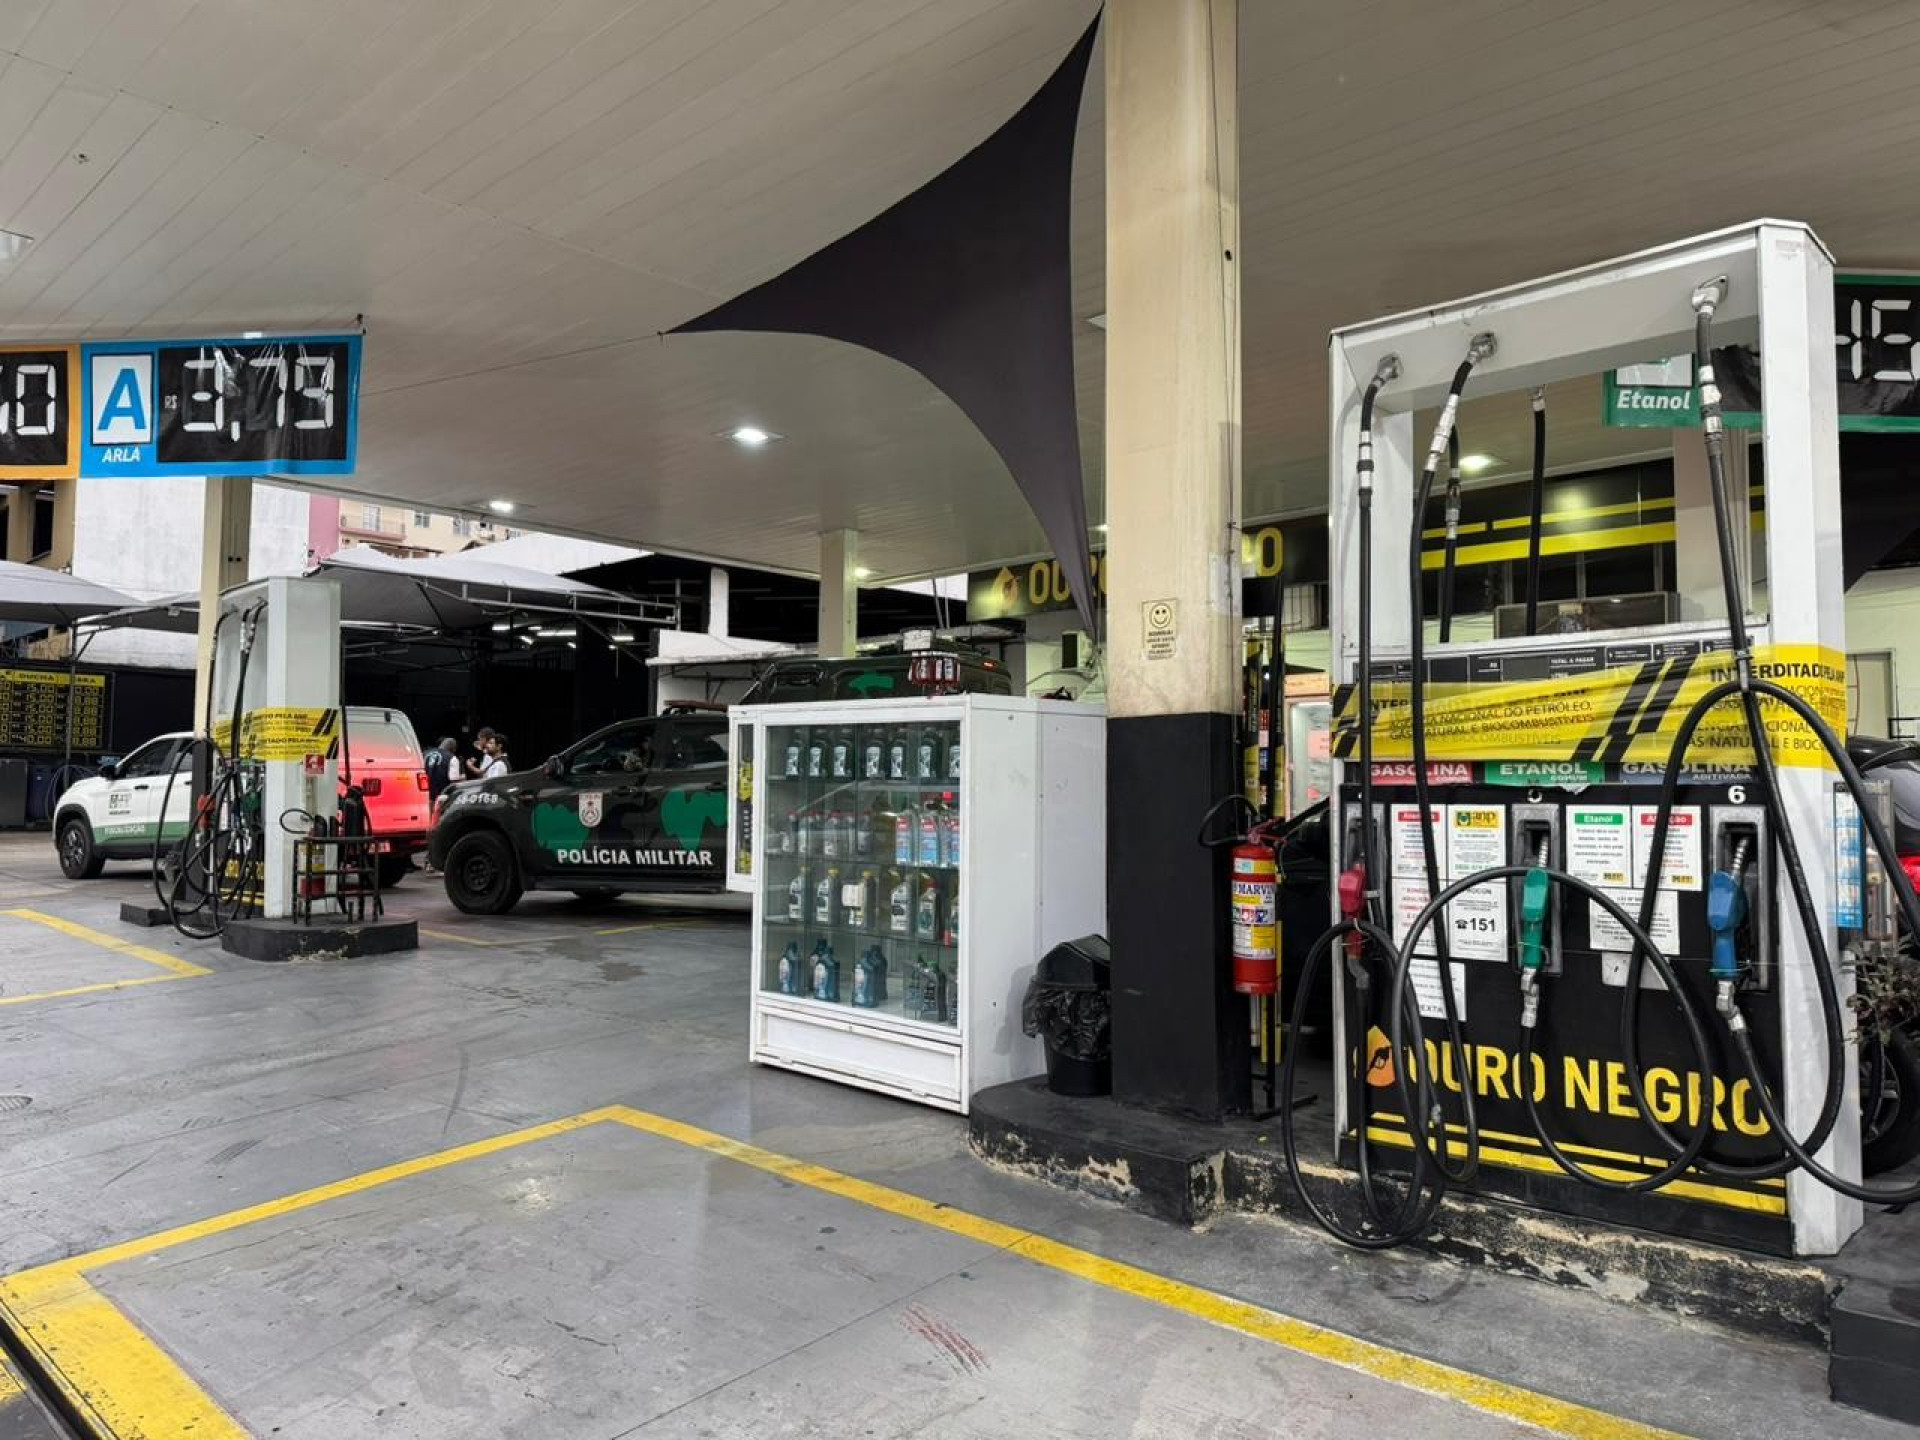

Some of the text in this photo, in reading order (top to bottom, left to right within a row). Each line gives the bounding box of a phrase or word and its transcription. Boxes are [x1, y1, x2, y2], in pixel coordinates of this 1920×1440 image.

[97, 368, 146, 430] A
[1616, 390, 1690, 410] Etanol
[102, 446, 141, 463] ARLA
[1504, 706, 1523, 718] DO
[1500, 762, 1588, 775] ETANOL
[1692, 773, 1752, 781] ADITIVADA
[1728, 785, 1747, 804] 6
[1583, 813, 1613, 823] Etanol
[557, 845, 713, 866] POLÍCIA MILITAR
[1470, 917, 1495, 932] 151
[1563, 1055, 1772, 1137] NEGRO
